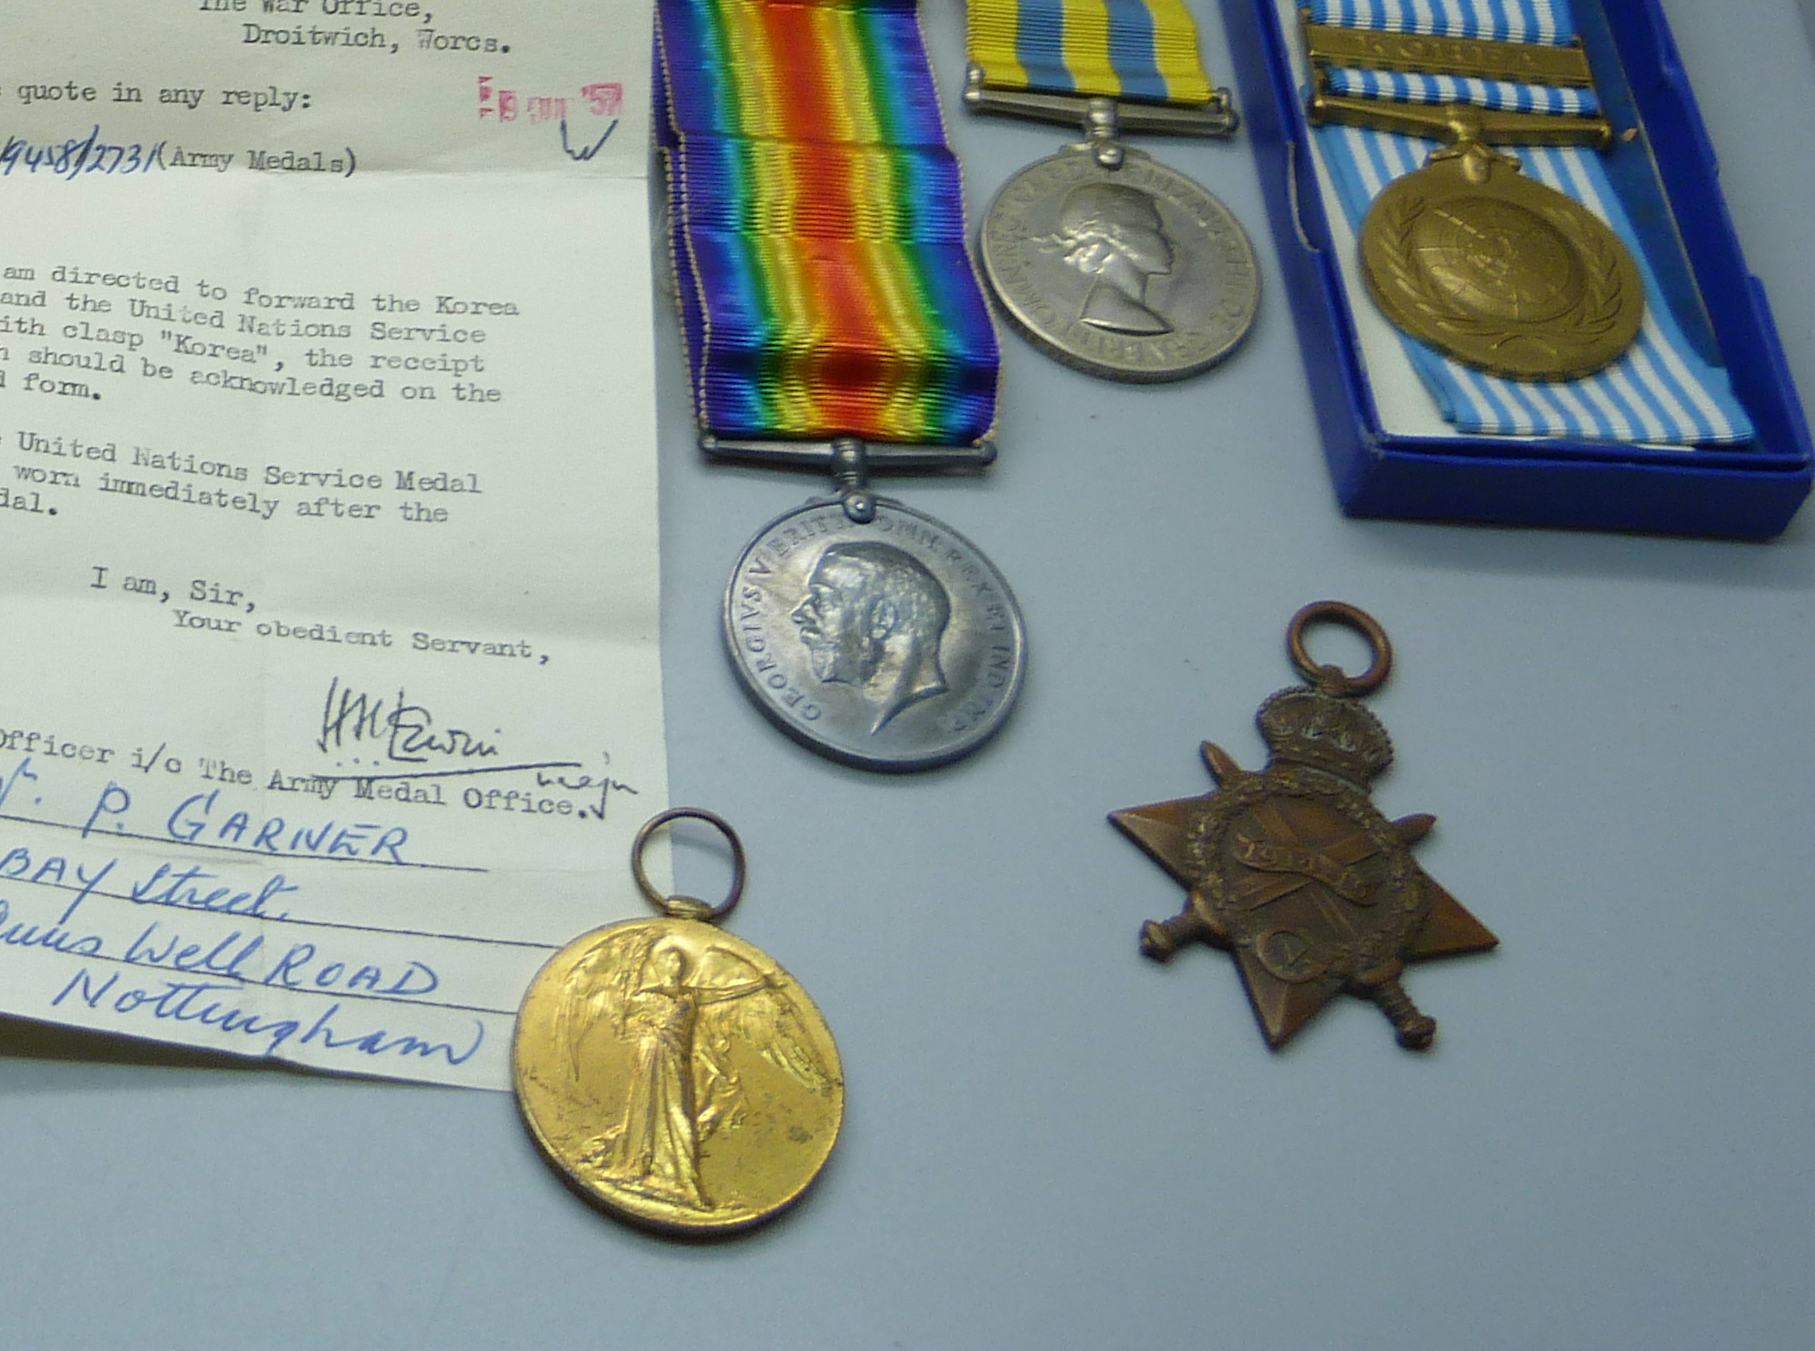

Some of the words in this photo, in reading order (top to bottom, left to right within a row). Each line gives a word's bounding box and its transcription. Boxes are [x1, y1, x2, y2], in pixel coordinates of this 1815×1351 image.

[242, 23, 400, 54] Droitwich,
[416, 28, 512, 54] Worcs.
[17, 80, 97, 104] quote
[112, 83, 143, 103] in
[159, 87, 204, 110] any
[222, 86, 312, 112] reply:
[248, 148, 357, 178] Medals)
[0, 290, 47, 308] and
[66, 292, 112, 313] the
[129, 298, 224, 330] United
[237, 313, 352, 339] Nations
[370, 321, 487, 343] Service
[3, 266, 35, 281] am
[51, 265, 180, 294] directed
[196, 278, 227, 301] to
[243, 287, 355, 312] forward
[372, 293, 421, 313] the
[435, 295, 520, 317] Korea
[28, 346, 126, 374] should
[141, 356, 174, 380] be
[190, 368, 385, 402] acknowledged
[400, 384, 436, 400] on
[451, 382, 501, 403] the
[62, 321, 144, 351] clasp
[305, 347, 354, 369] the
[370, 352, 485, 378] receipt
[23, 372, 102, 400] form.
[18, 430, 118, 463] United
[132, 446, 249, 483] Nations
[264, 465, 384, 490] Service
[394, 470, 483, 494] Medal
[13, 465, 81, 488] worn
[99, 472, 280, 520] immediately
[296, 497, 383, 520] after
[399, 501, 449, 523] the
[90, 566, 109, 590] I
[123, 576, 170, 604] am,
[189, 579, 257, 615] Sir,
[172, 609, 242, 634] Your
[256, 620, 394, 648] obedient
[412, 631, 551, 666] Servant,
[740, 585, 822, 723] GEORGIVS
[198, 757, 252, 788] The
[268, 769, 338, 801] Army
[354, 777, 447, 807] Medal
[463, 787, 587, 819] Office.
[167, 787, 410, 864] GARNER
[126, 923, 262, 981] Well
[264, 943, 441, 995] ROAD
[52, 968, 487, 1066] Nottingham
